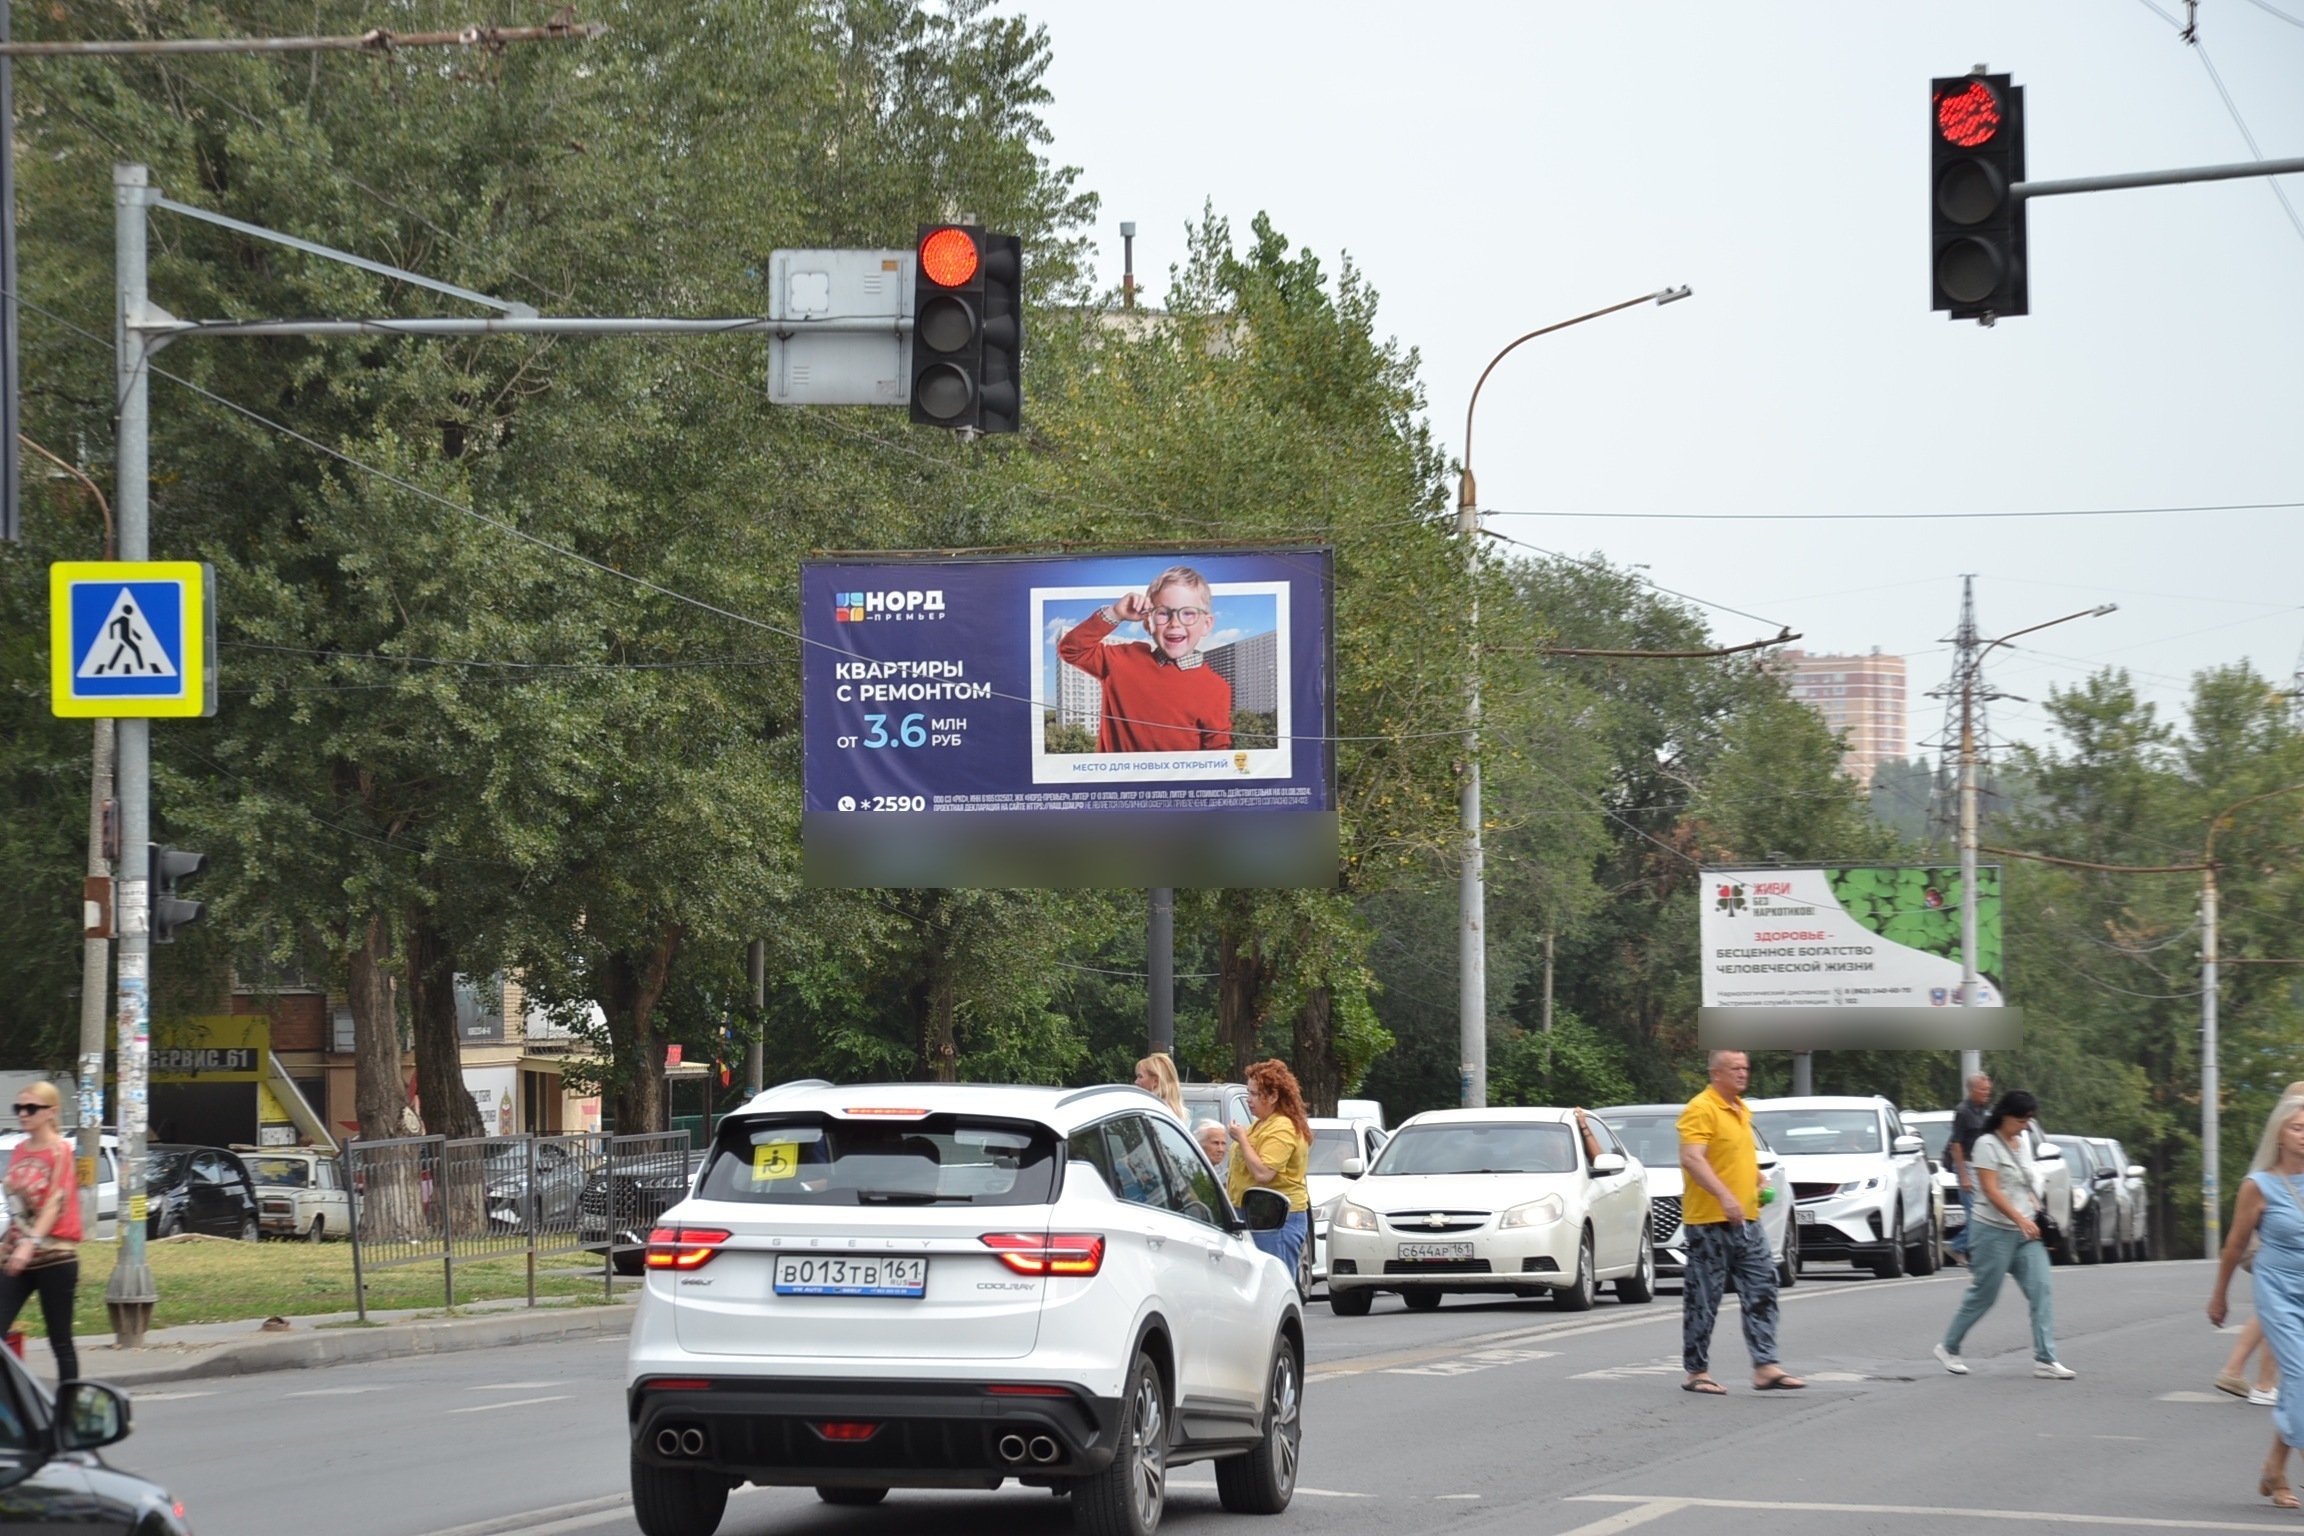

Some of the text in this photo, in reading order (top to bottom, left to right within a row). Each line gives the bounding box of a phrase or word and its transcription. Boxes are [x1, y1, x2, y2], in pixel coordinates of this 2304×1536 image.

[866, 590, 946, 612] НОРД
[835, 660, 964, 680] КВАРТИРЫ
[836, 682, 992, 702] С РЕМОНТОМ
[836, 712, 967, 748] ОТ 3.6 МЛН
[931, 734, 962, 746] РУБ
[1072, 758, 1228, 772] МЕСТО ДЛЯ НОВЫХ ОТКРЫТИЙ
[1753, 882, 1791, 895] ЖИВИ
[1753, 896, 1770, 906] БЕЗ
[1754, 931, 1826, 942] ЗДОРОВЬЕ
[1716, 946, 1874, 959] БЕСЦЕННОЕ БОГАТСТВО
[1716, 961, 1874, 975] ЧЕЛОВЕЧЕСКОЙ ЖИЗНИ
[772, 1238, 931, 1248] GEELY
[884, 1260, 920, 1280] 161
[976, 1282, 1036, 1291] COOLRAY
